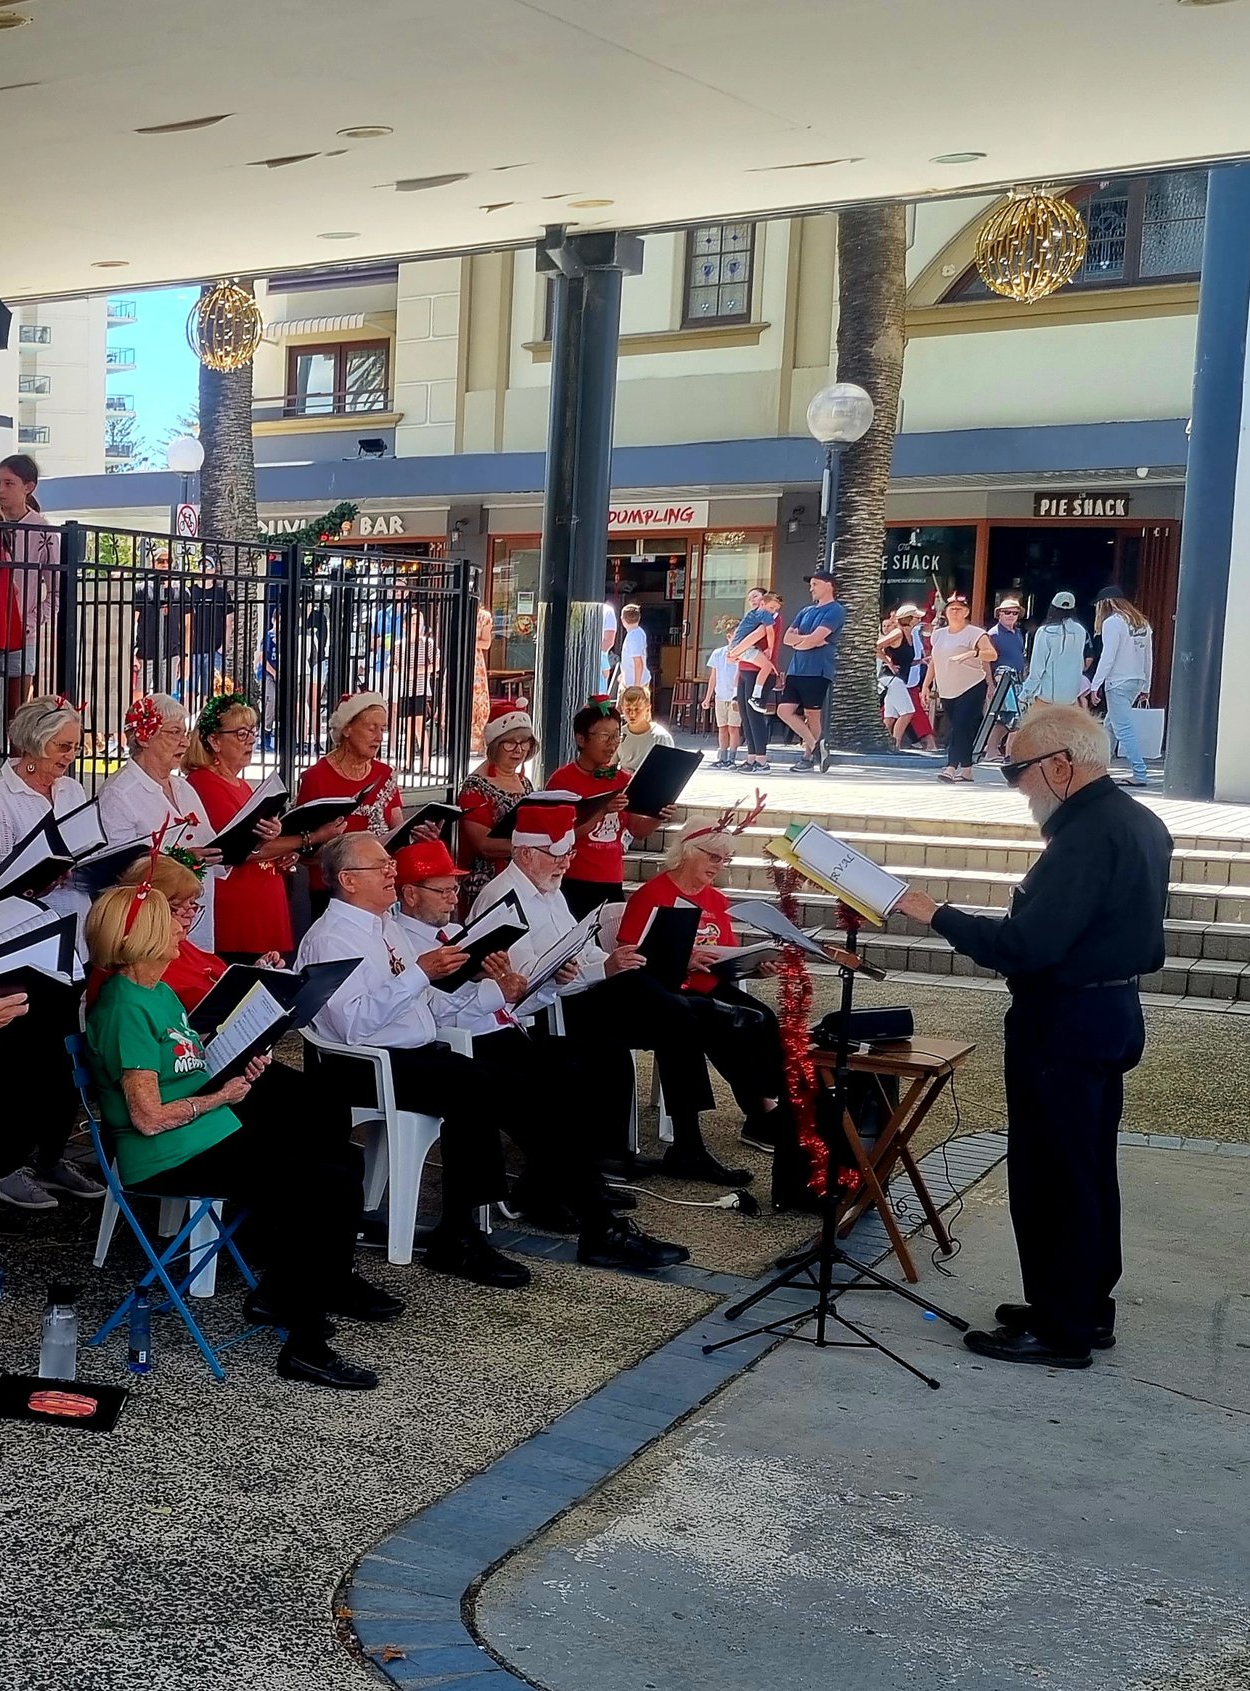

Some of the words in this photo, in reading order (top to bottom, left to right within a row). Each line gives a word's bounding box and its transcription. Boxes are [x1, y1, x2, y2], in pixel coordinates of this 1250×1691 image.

[608, 506, 695, 526] DUMPLING
[1040, 498, 1069, 517] PIE
[1072, 498, 1126, 517] SHACK
[359, 515, 405, 537] BAR
[892, 554, 940, 571] SHACK
